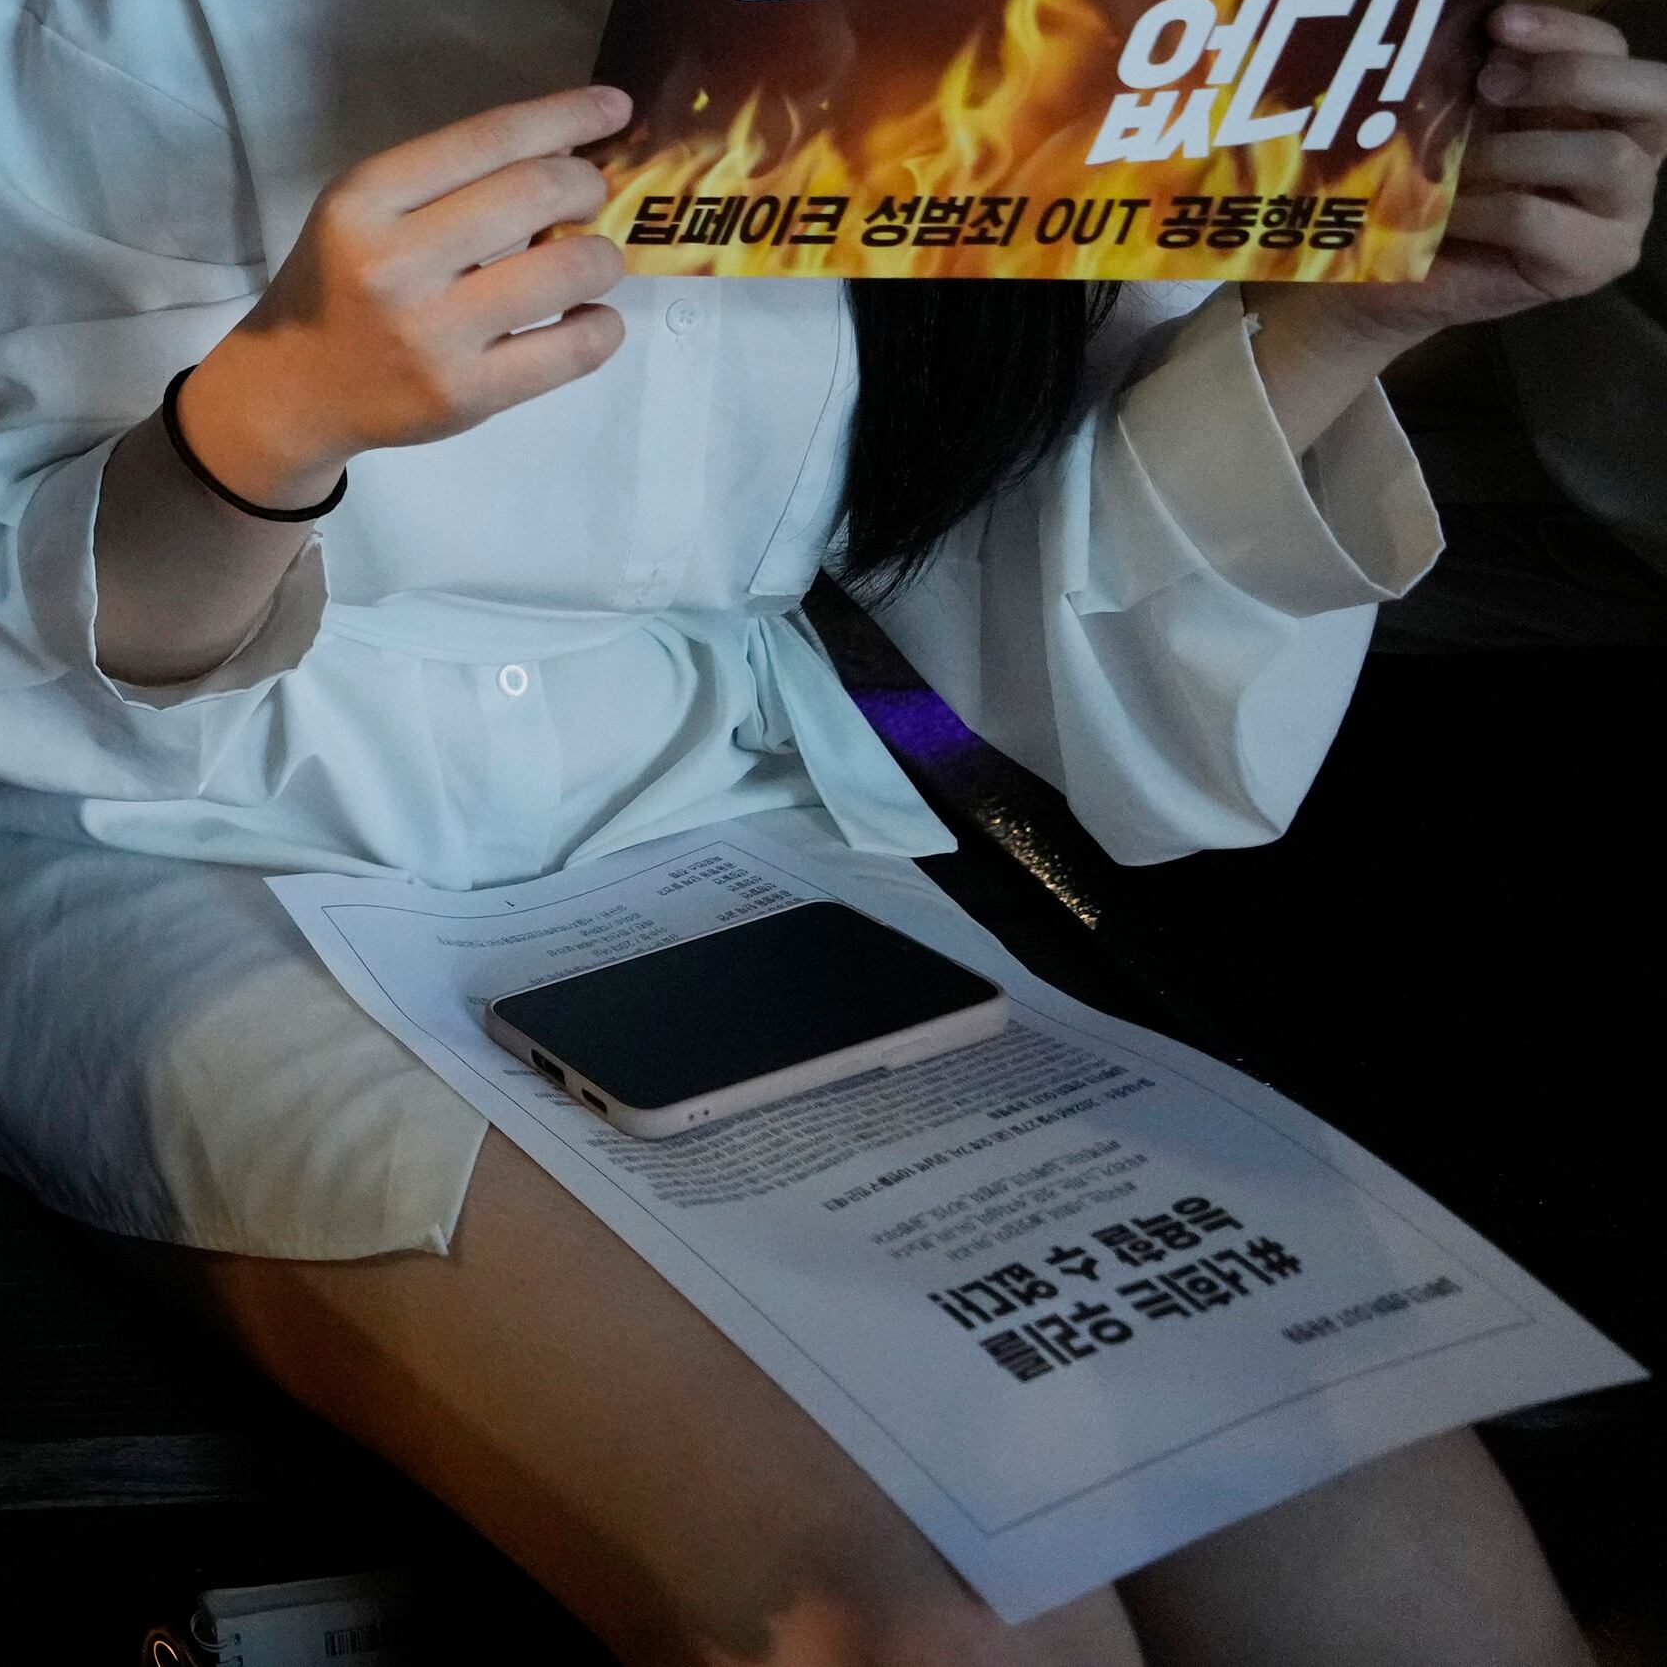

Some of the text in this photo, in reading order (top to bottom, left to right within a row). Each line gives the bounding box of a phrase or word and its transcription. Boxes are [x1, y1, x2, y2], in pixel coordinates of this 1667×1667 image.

[625, 195, 1369, 251] 딥페이크 성범죄 OUT 공동행동
[1010, 1120, 1037, 1135] 27일
[928, 1196, 1244, 1330] 능욕할 수 없다!
[980, 1237, 1301, 1383] #너희는 우리를
